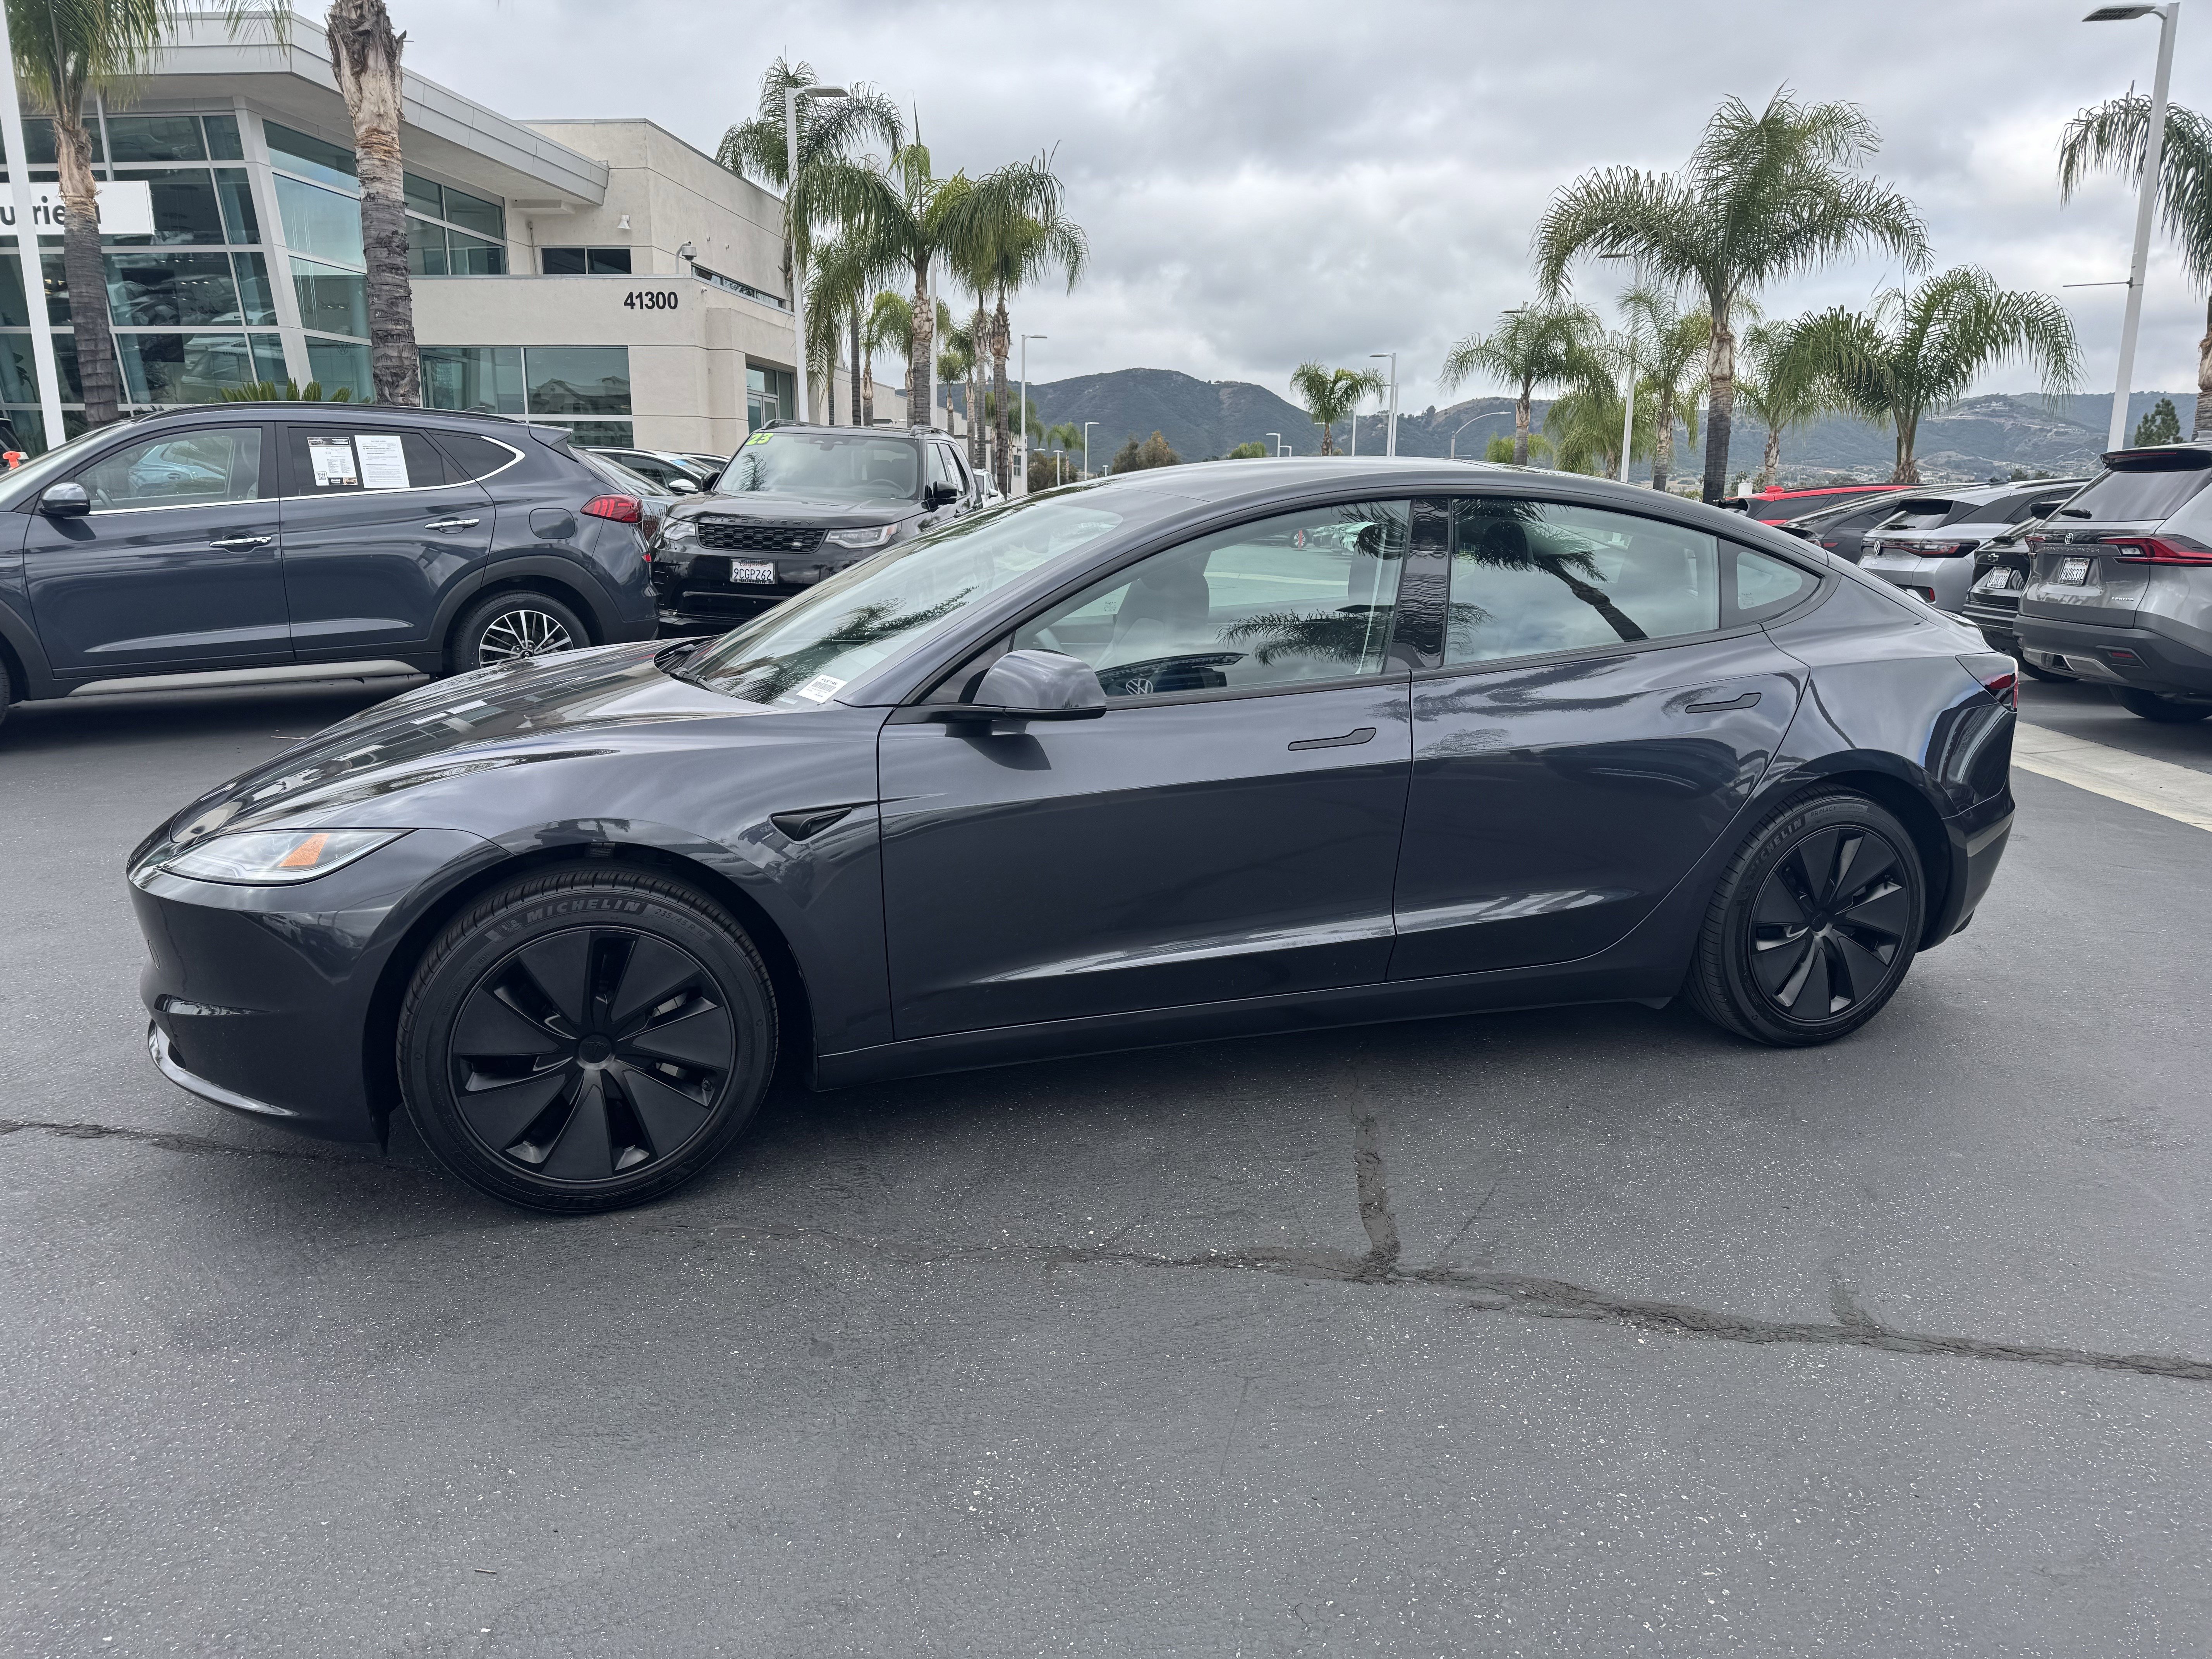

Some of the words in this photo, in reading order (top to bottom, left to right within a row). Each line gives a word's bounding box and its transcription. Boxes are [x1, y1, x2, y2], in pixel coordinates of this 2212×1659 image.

[624, 291, 678, 309] 41300
[746, 433, 774, 445] 23
[709, 516, 815, 526] DISCOVERY
[734, 568, 771, 580] 9CGP262
[1749, 818, 1802, 880] MICHELIN
[1811, 806, 1837, 817] PRIMACY
[527, 899, 640, 923] MICHELIN
[655, 909, 687, 925] 235/45
